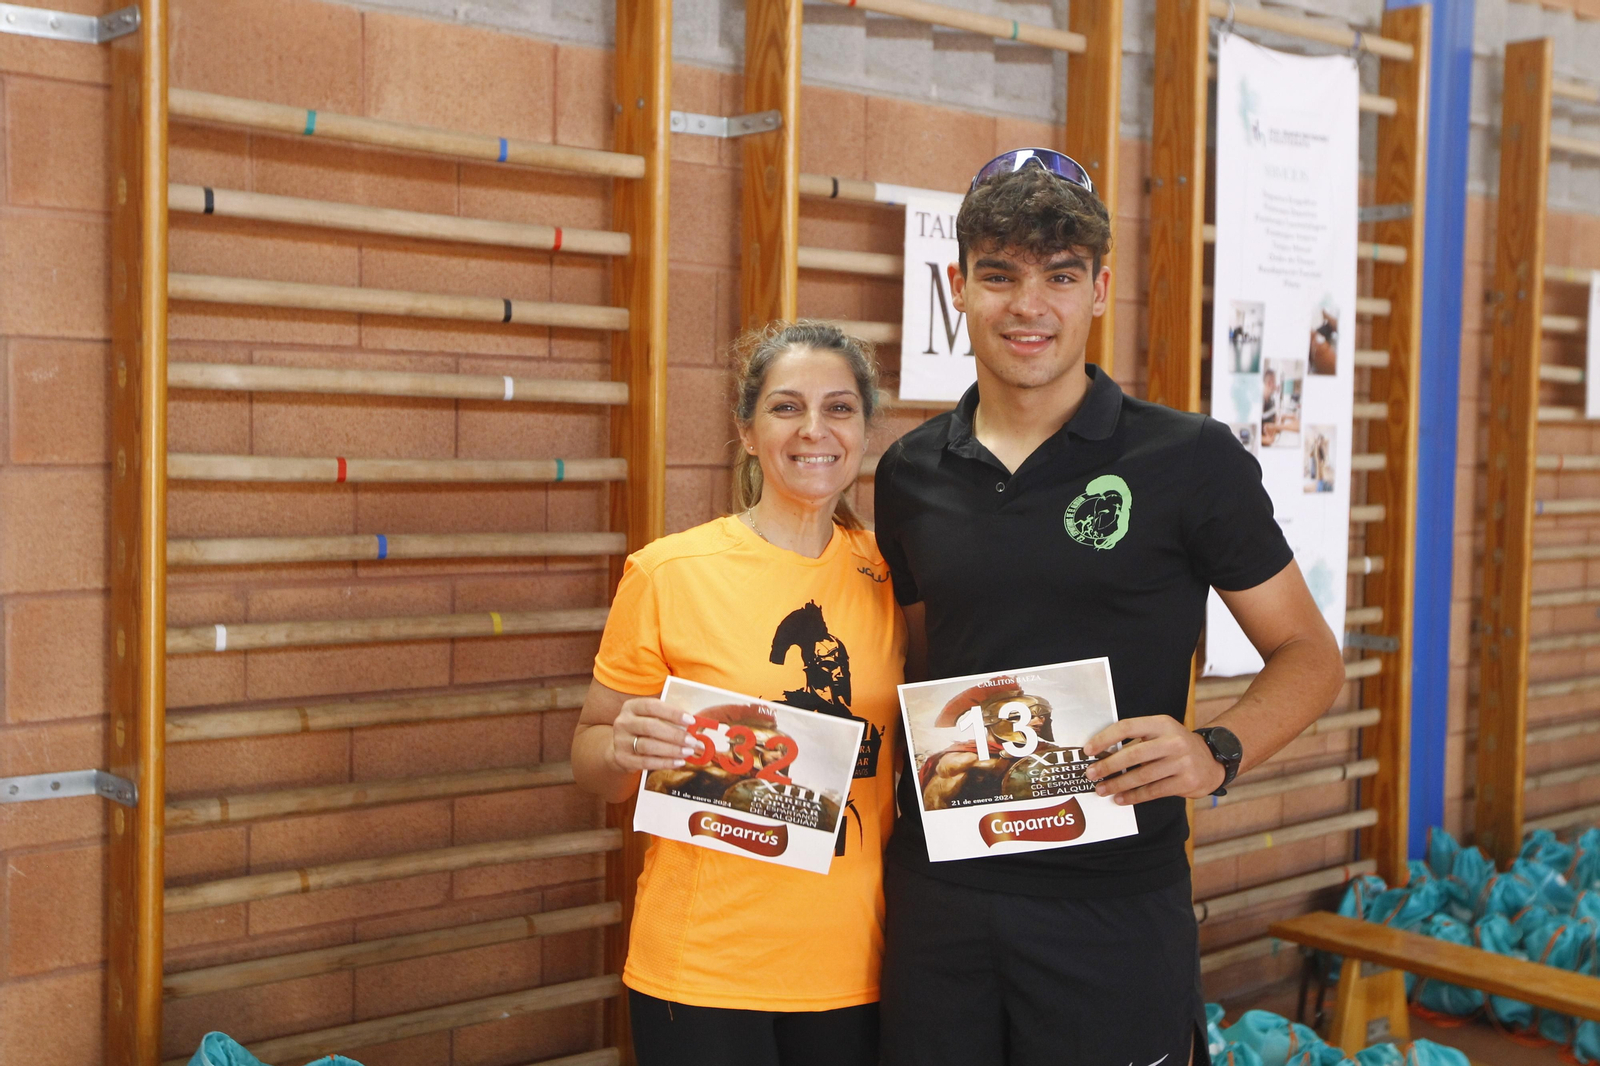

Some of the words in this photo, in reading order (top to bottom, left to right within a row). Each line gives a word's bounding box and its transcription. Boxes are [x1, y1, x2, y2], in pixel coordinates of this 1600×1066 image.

[977, 678, 1015, 688] CARLITOS
[1016, 674, 1042, 683] BAEZA
[958, 701, 1040, 762] 13
[684, 715, 799, 786] 532
[1029, 763, 1090, 776] CARRER
[671, 789, 681, 797] 21
[692, 795, 712, 803] enero
[713, 798, 732, 807] 2024
[753, 788, 822, 811] CARRERA
[993, 794, 1014, 802] 2024
[1032, 789, 1054, 798] DEL
[749, 806, 770, 816] DEL
[752, 796, 819, 817] POPULAR
